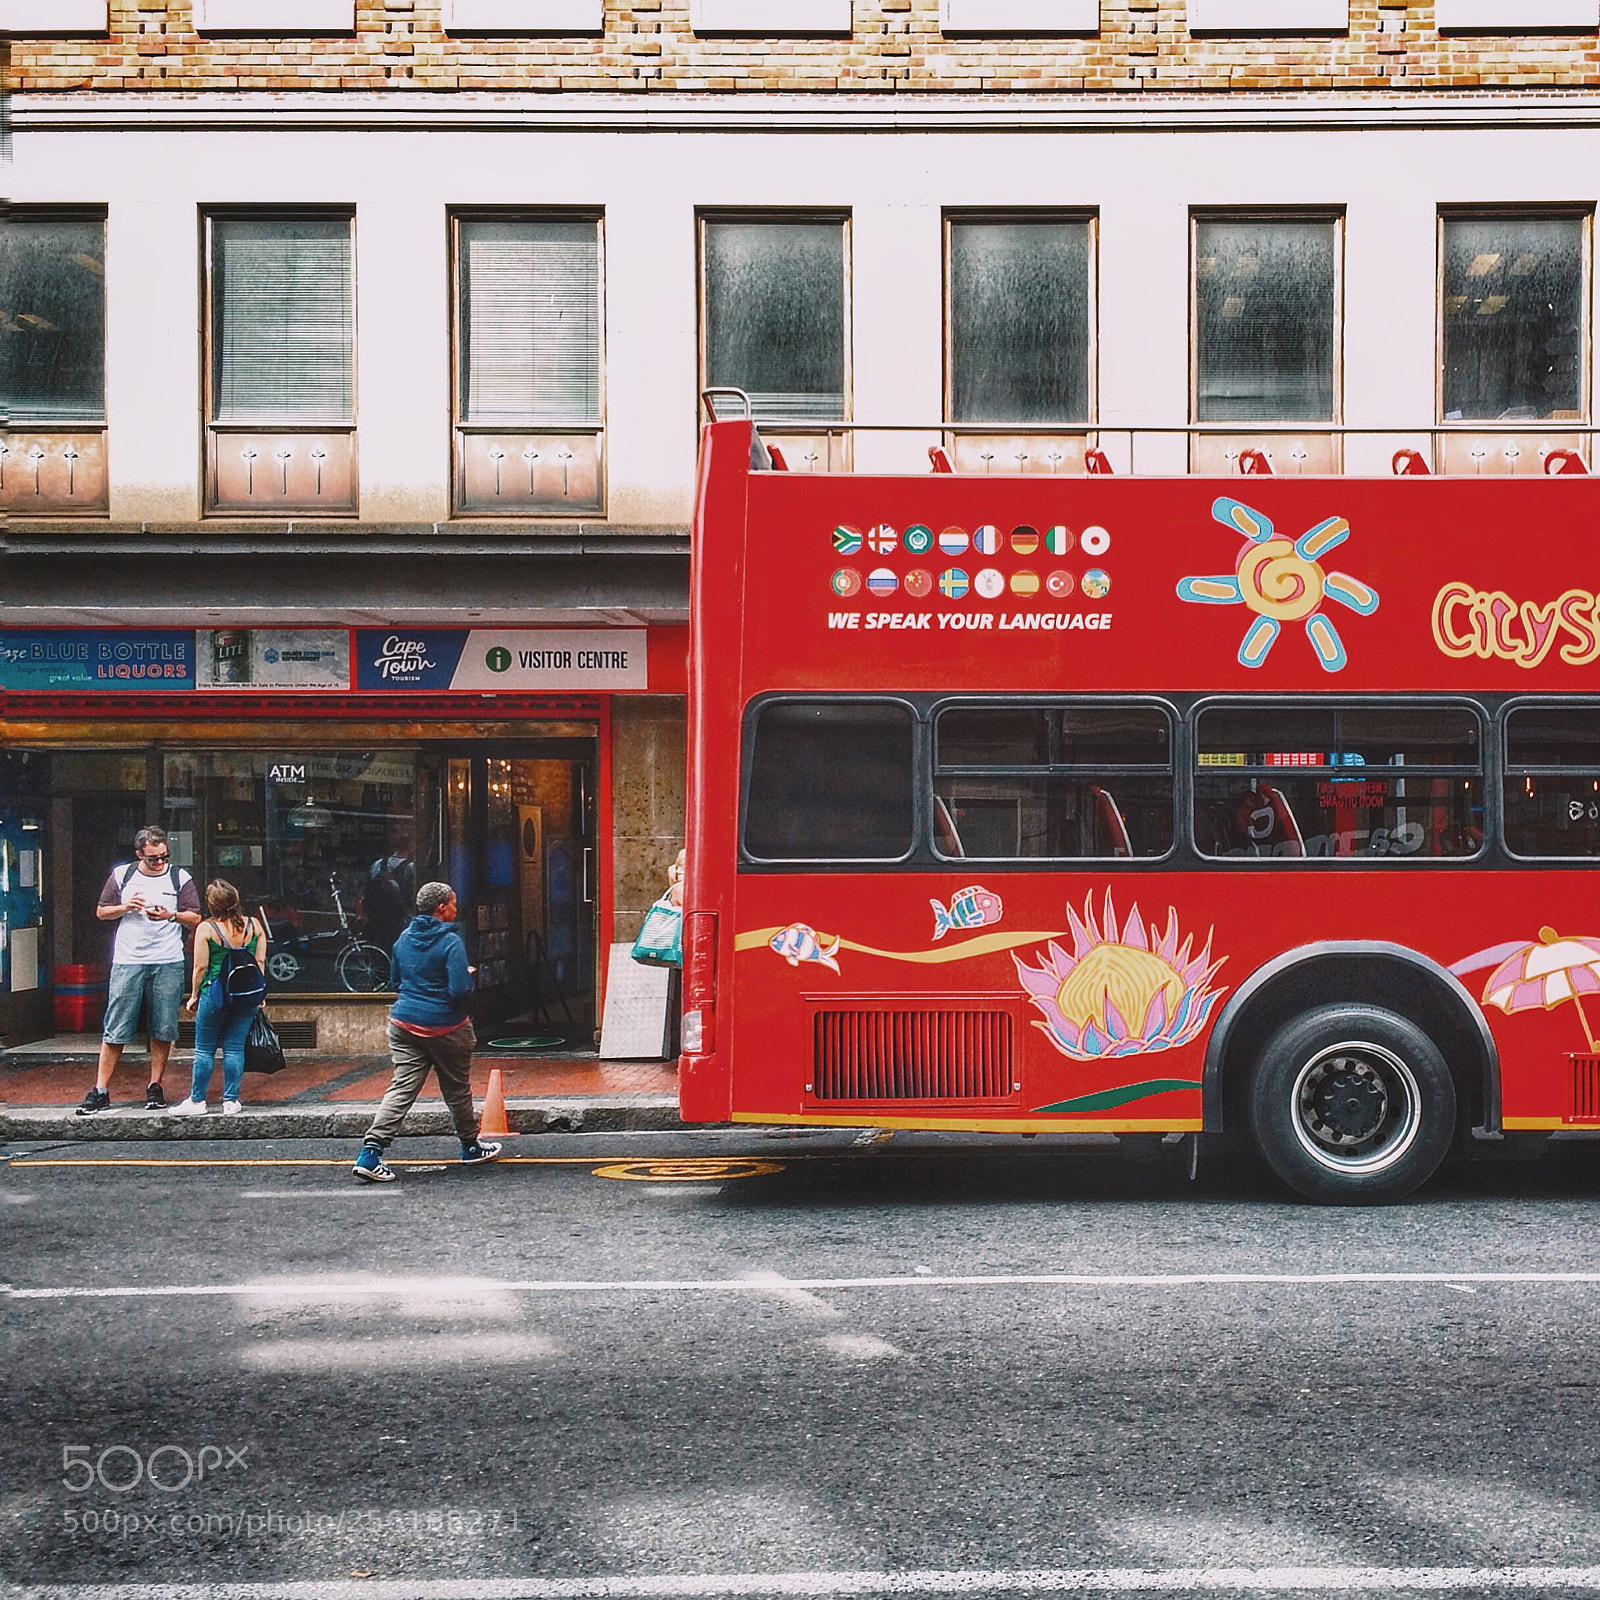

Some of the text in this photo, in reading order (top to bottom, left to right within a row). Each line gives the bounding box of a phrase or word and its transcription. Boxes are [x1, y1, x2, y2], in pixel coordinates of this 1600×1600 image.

[828, 612, 1113, 630] WE SPEAK YOUR LANGUAGE
[30, 642, 185, 660] BLUE BOTTLE
[218, 644, 244, 659] LITE
[382, 635, 427, 660] Cape
[374, 655, 437, 678] Town
[518, 650, 572, 669] VISITOR
[577, 650, 629, 669] CENTRE
[49, 673, 92, 683] great value
[97, 664, 187, 679] LIQUORS
[269, 764, 305, 778] ATM
